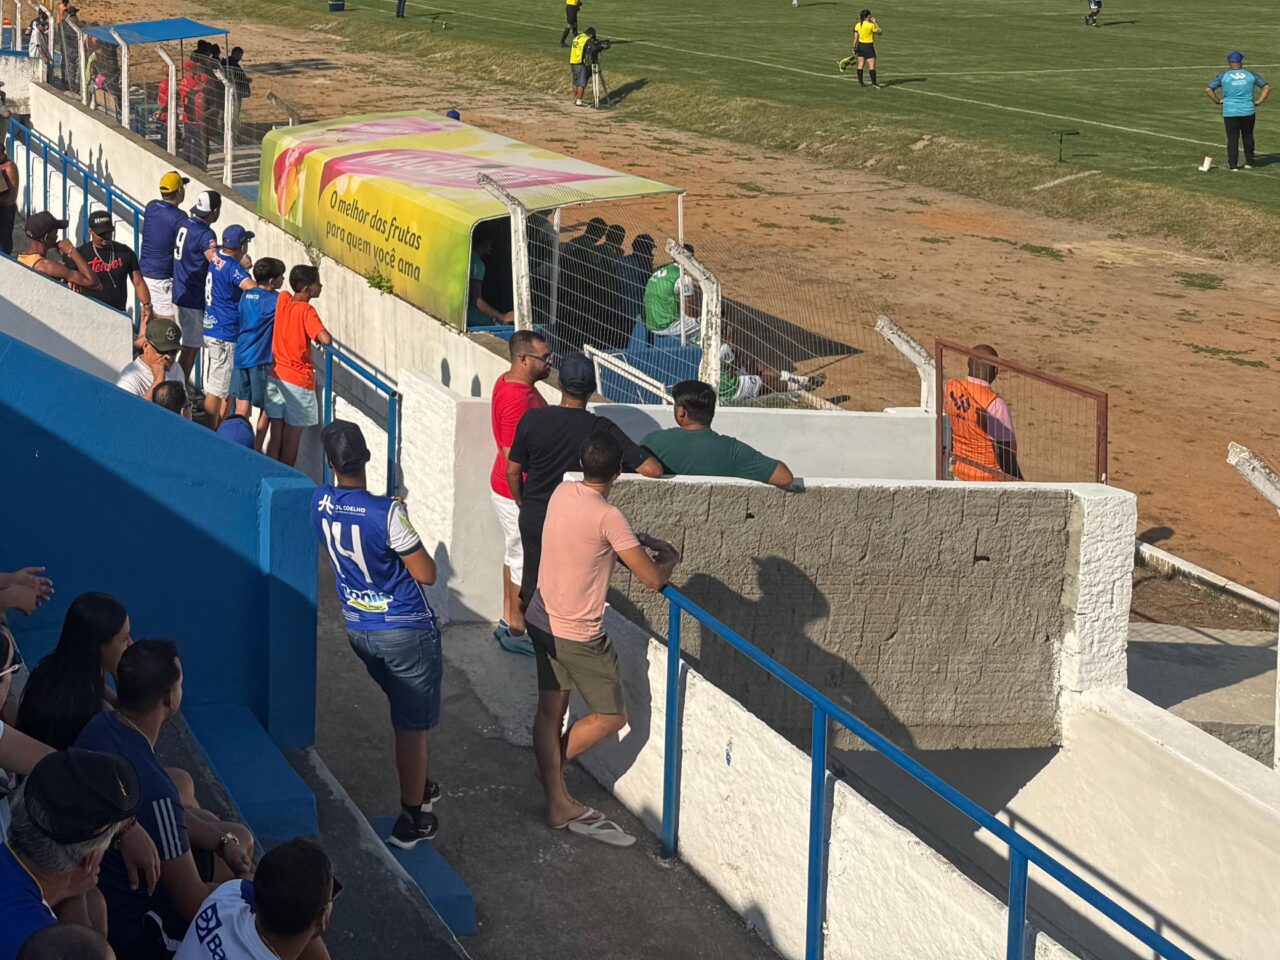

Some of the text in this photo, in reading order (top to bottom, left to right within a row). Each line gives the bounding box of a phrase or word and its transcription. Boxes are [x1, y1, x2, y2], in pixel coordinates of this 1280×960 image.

[174, 226, 188, 261] 9
[330, 190, 422, 251] O melhor das frutas
[325, 221, 421, 282] para quem você ama
[321, 518, 373, 584] 14
